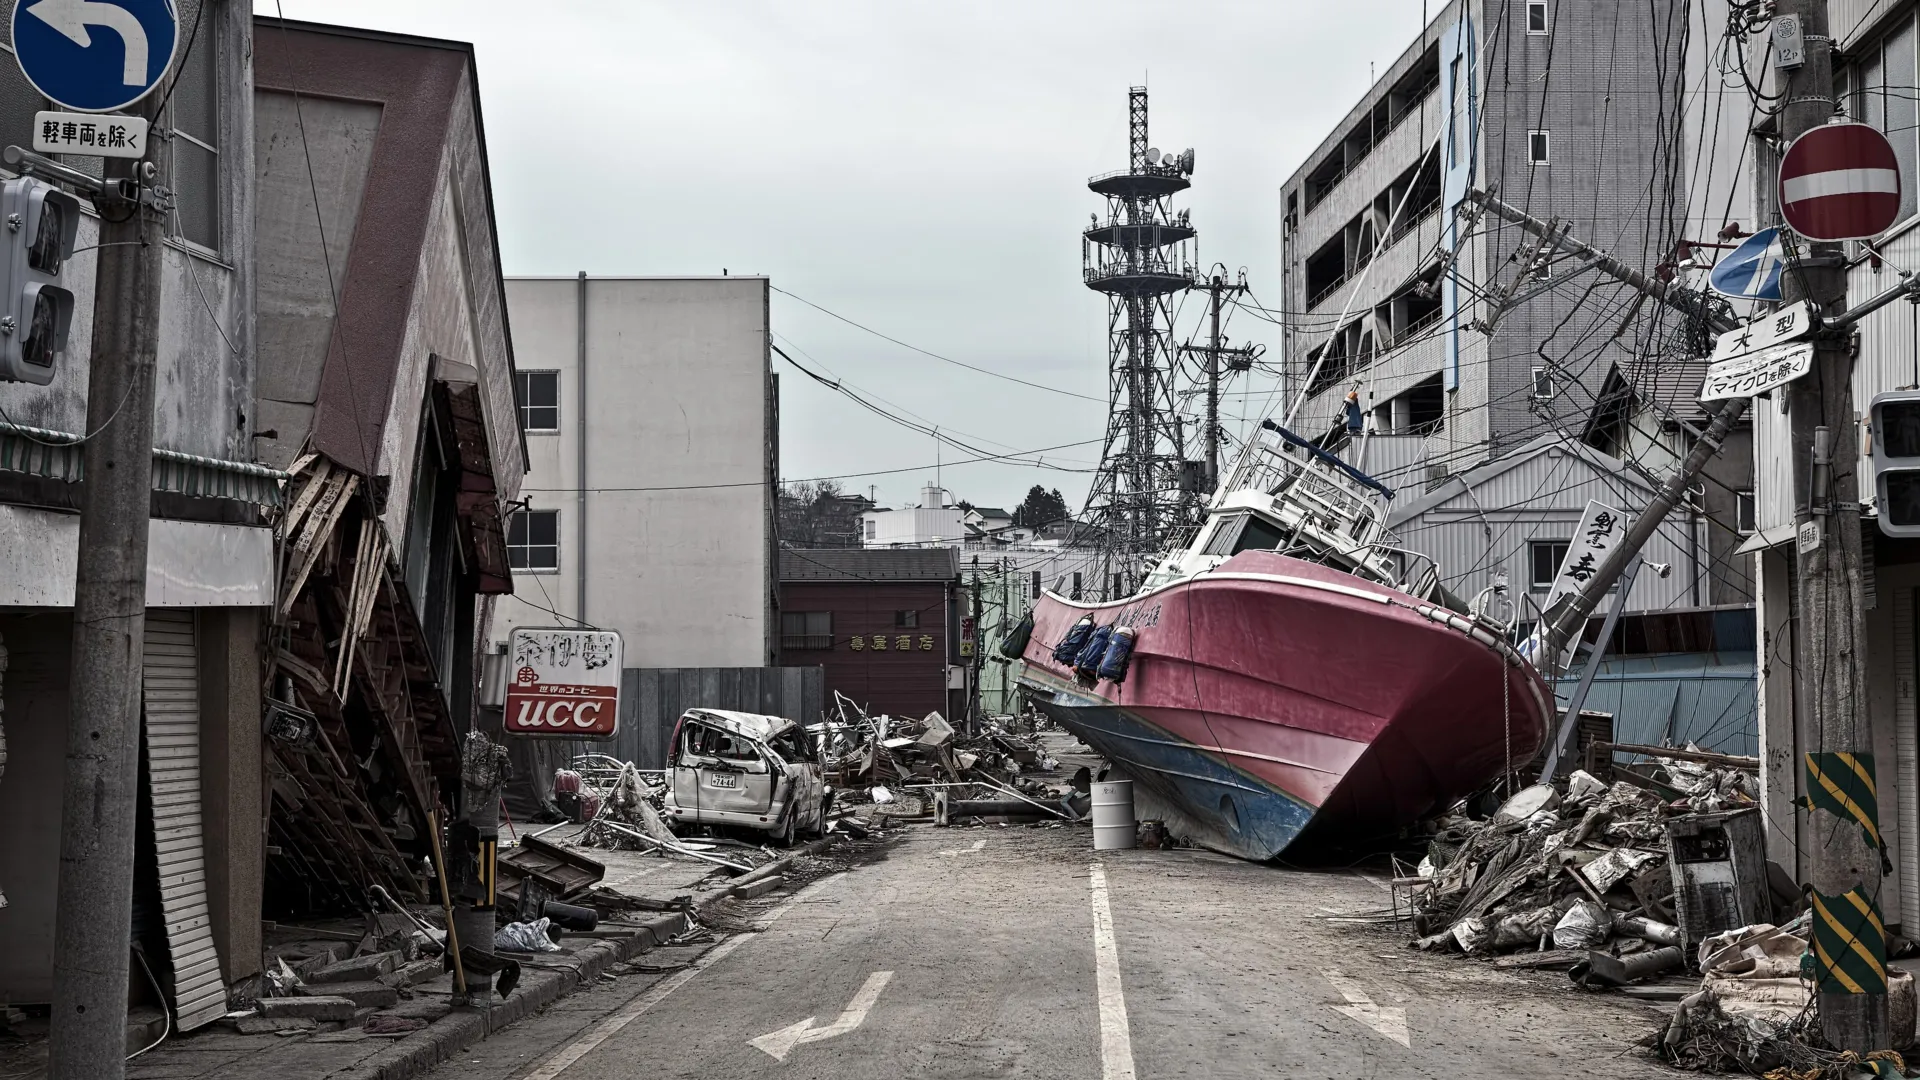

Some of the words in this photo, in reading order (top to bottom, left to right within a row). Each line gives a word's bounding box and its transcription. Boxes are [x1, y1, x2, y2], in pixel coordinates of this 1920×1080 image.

[42, 120, 137, 149] 軽車両を除く
[1730, 312, 1795, 353] 大型
[1708, 356, 1806, 396] (マイクロを除く)
[539, 685, 597, 695] 世界のコーヒー
